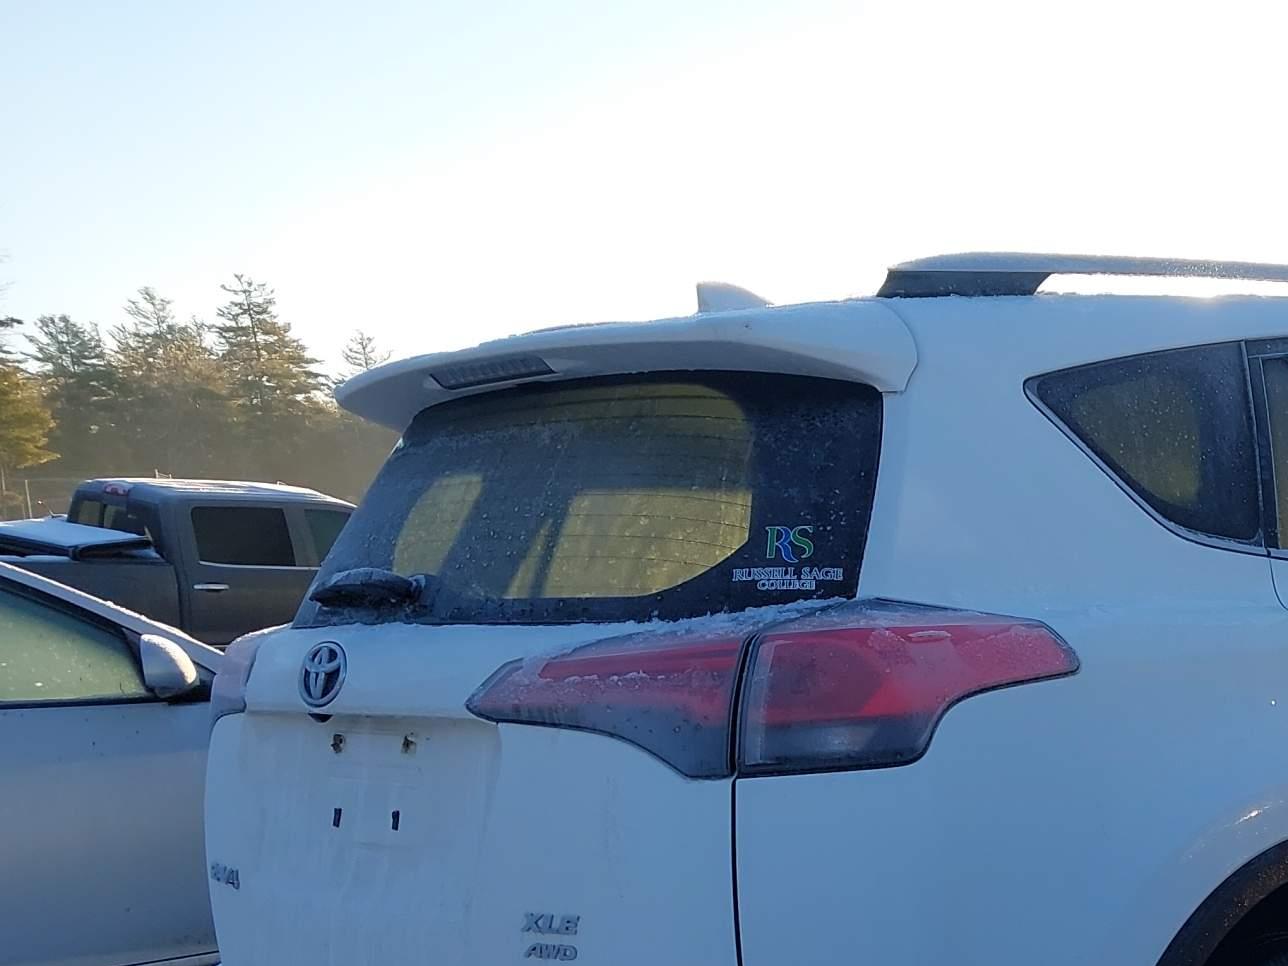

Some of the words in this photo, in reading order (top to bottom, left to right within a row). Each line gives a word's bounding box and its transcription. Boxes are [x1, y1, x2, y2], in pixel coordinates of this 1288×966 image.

[767, 526, 813, 563] RS
[733, 567, 797, 581] RUSSELL
[802, 567, 843, 581] SAGE
[757, 580, 815, 590] COLLEGE
[521, 912, 580, 936] XLE
[524, 942, 578, 961] AWD
